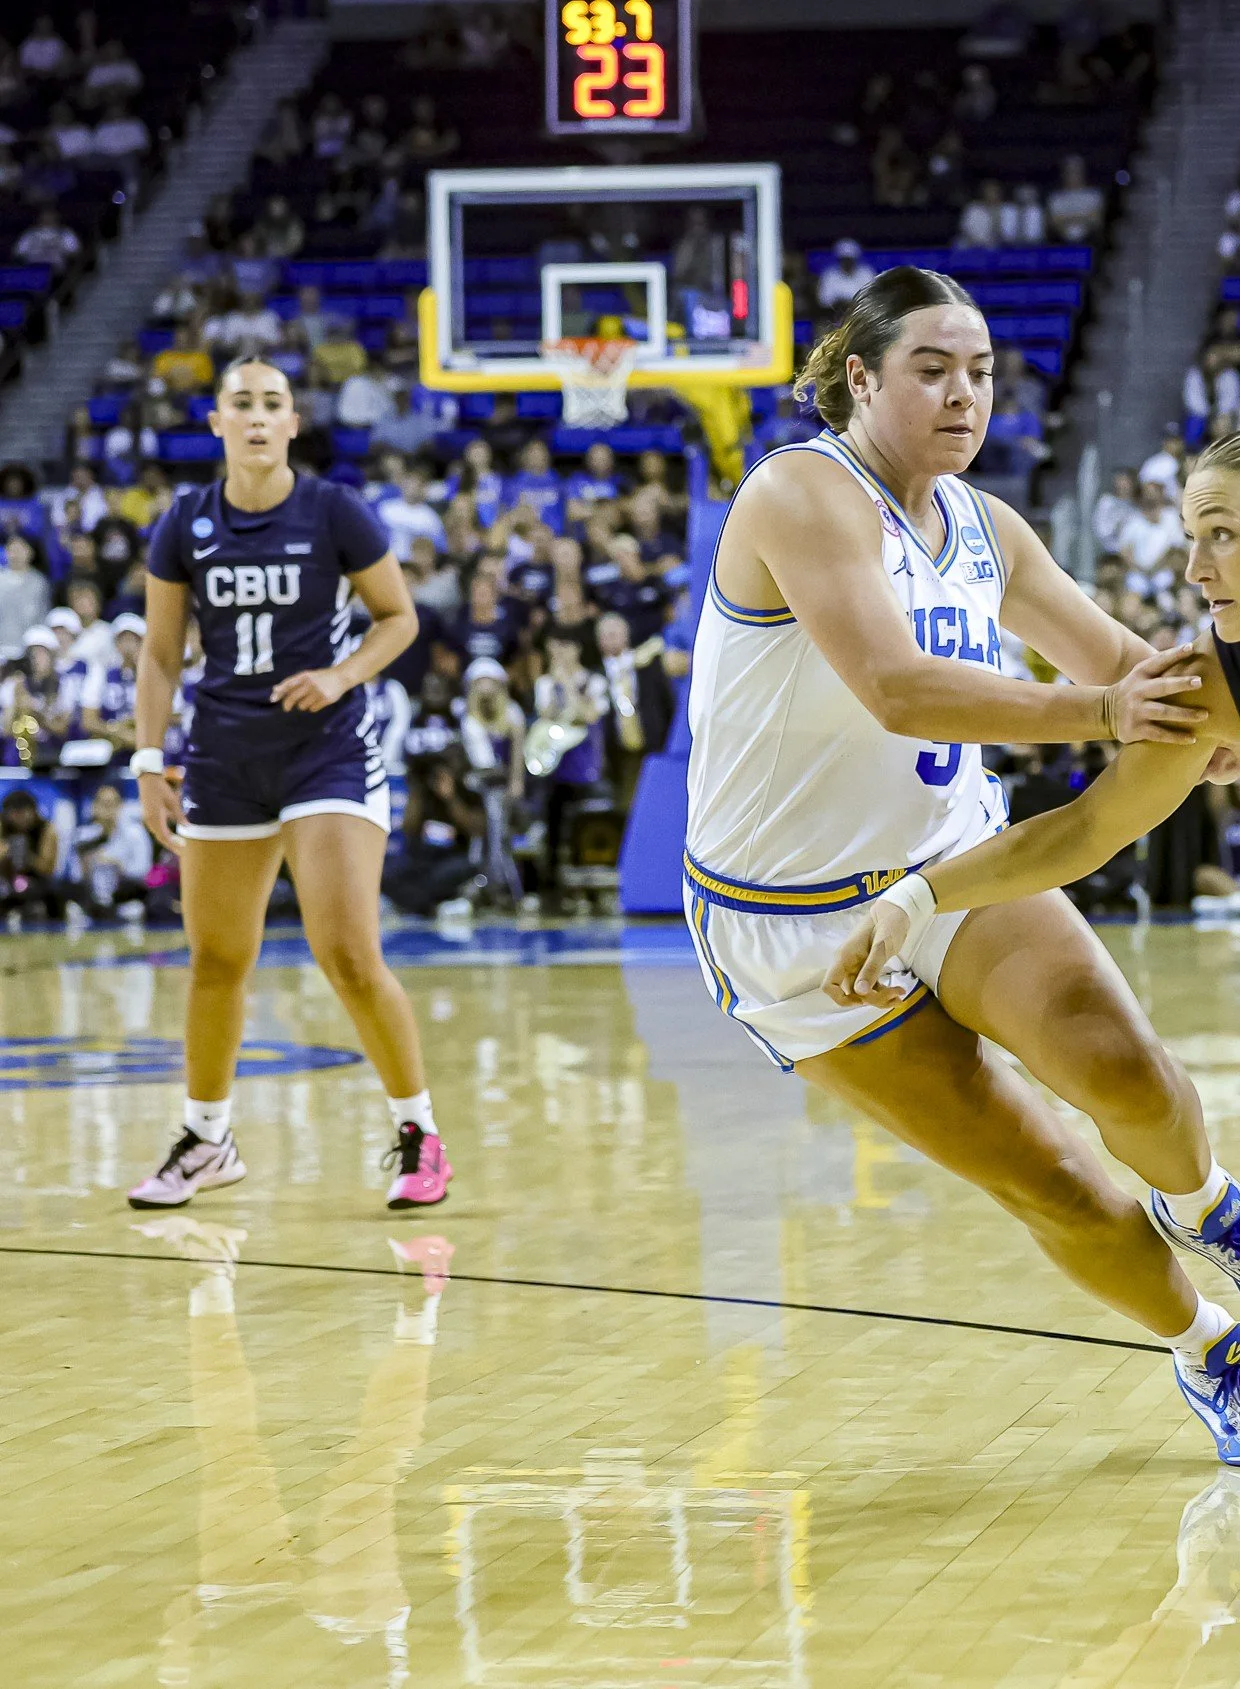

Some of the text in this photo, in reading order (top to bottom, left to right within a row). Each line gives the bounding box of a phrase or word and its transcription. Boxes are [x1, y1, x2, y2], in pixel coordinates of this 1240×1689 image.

[573, 42, 665, 118] 23
[206, 563, 301, 608] CBU
[233, 611, 275, 676] 11
